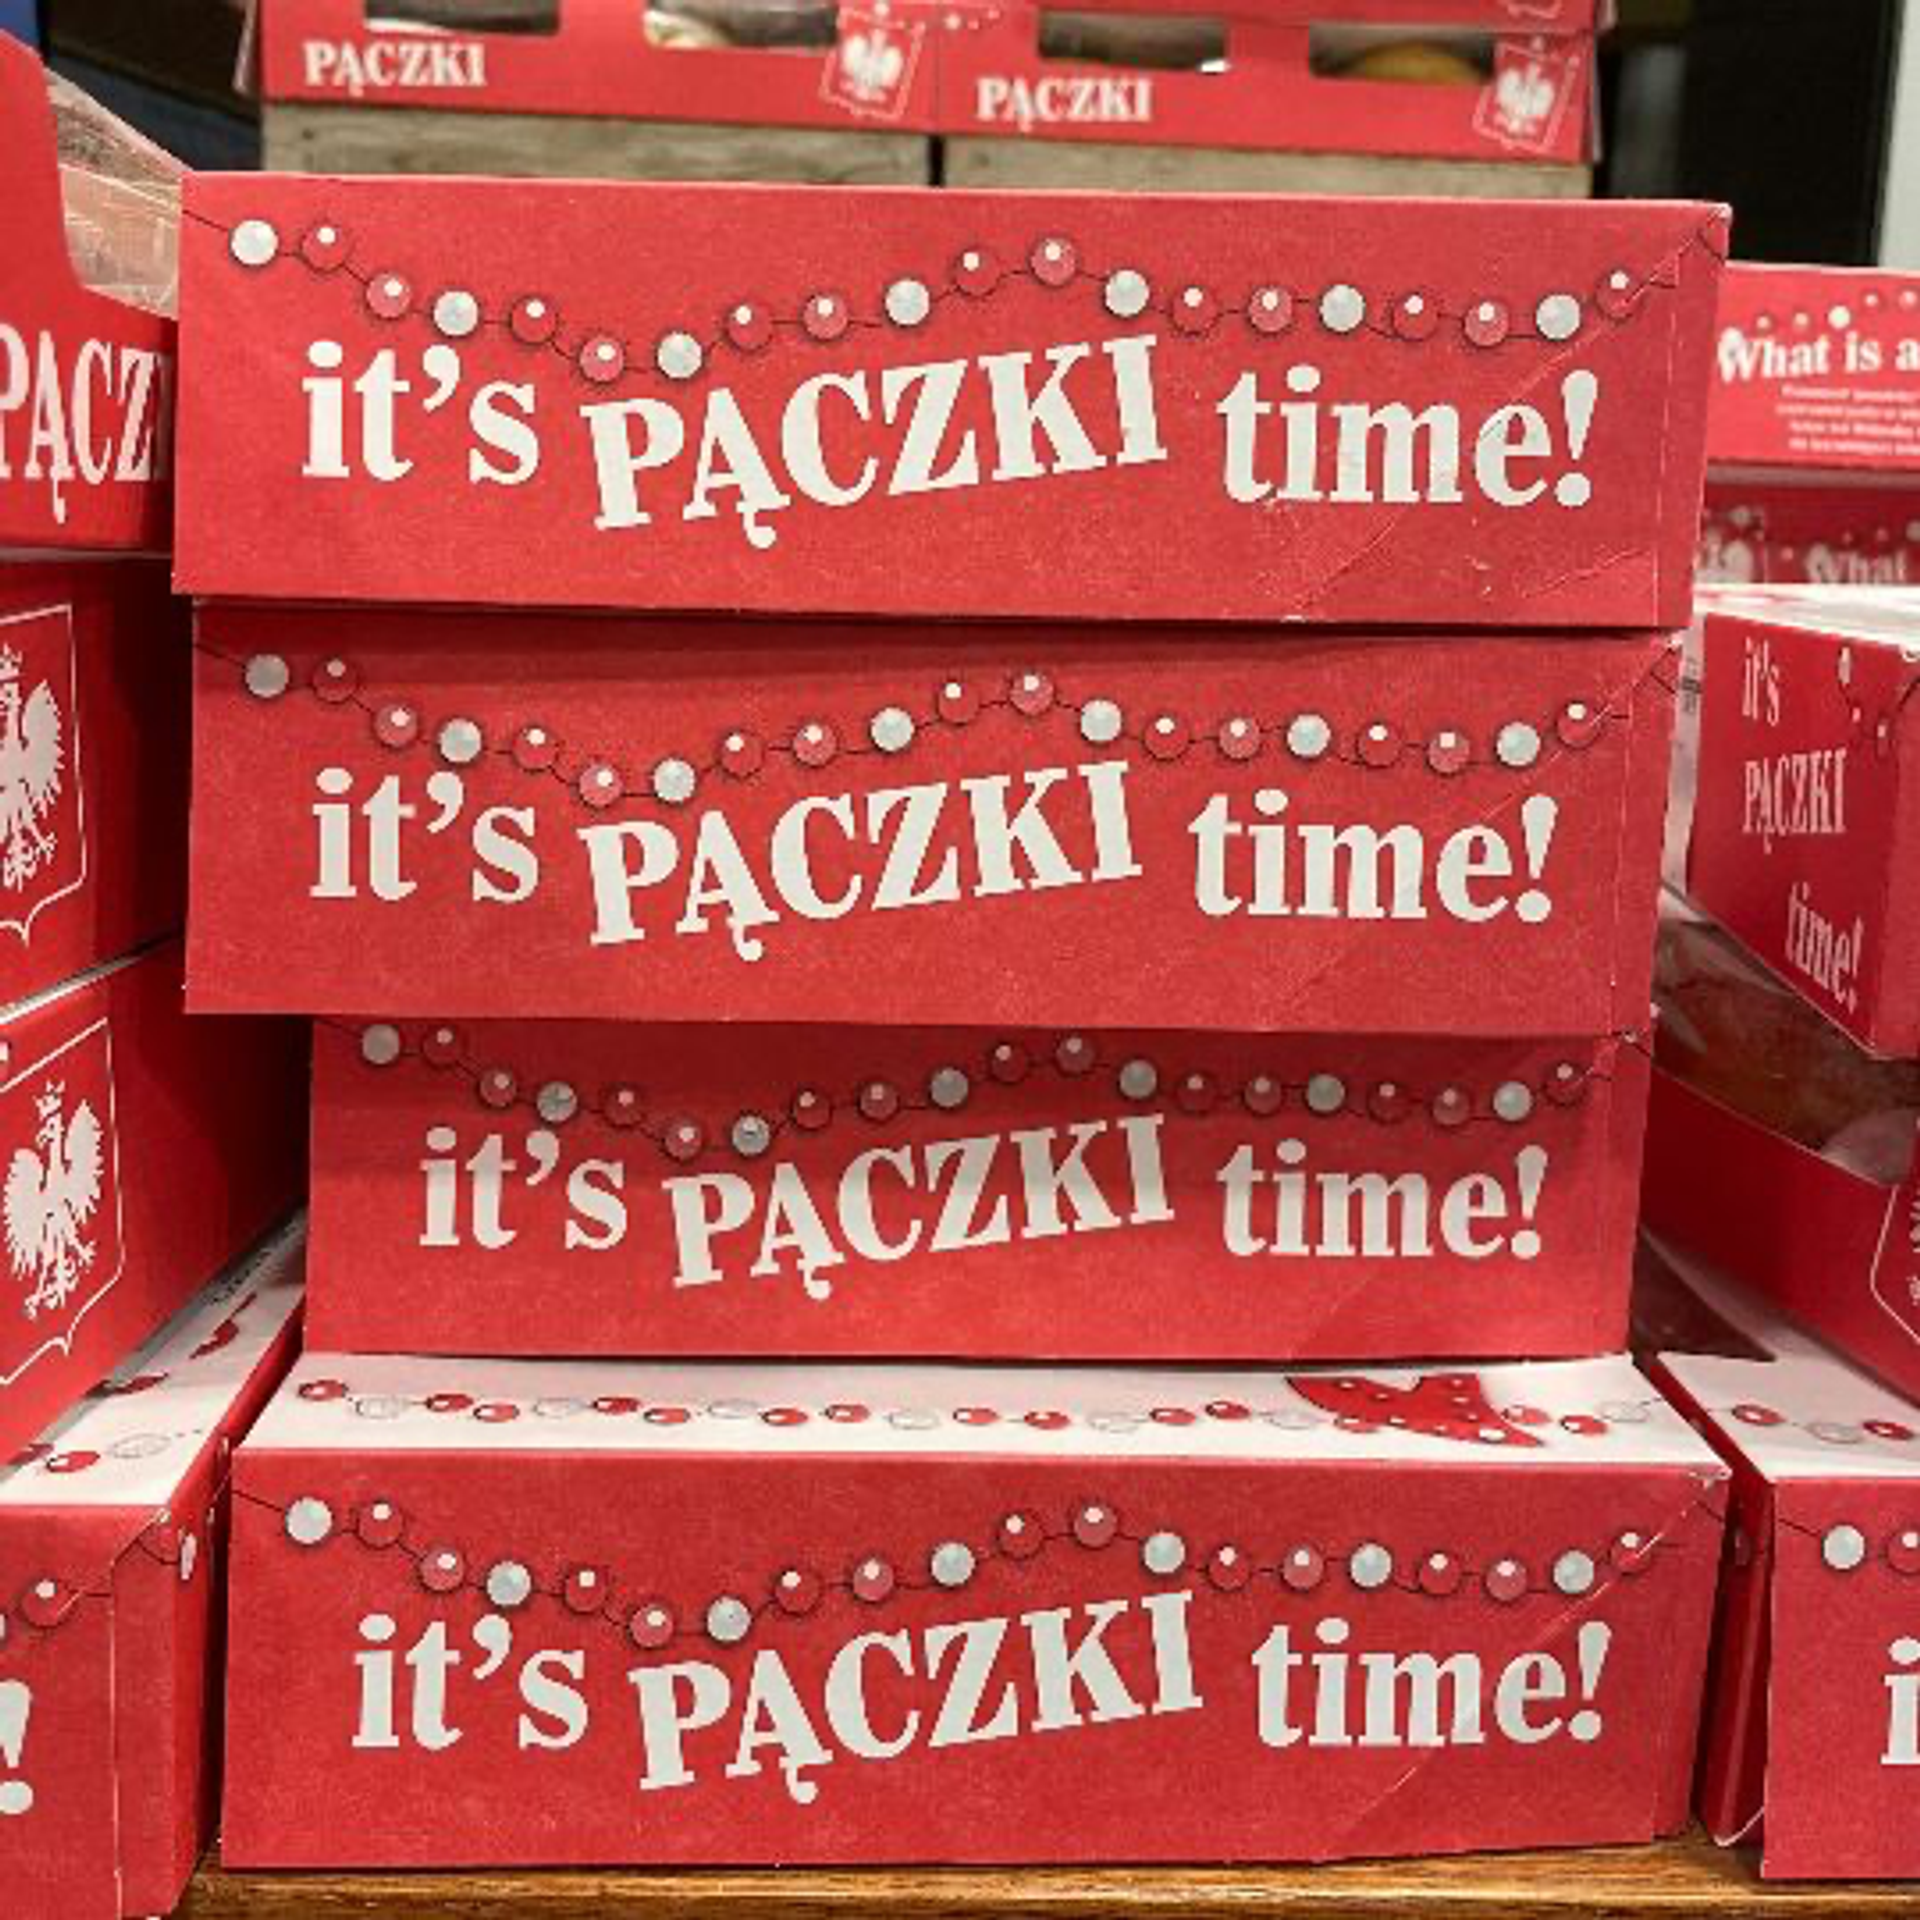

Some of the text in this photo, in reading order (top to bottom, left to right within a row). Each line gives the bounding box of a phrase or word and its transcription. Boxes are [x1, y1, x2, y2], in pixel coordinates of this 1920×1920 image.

[303, 41, 488, 96] PĄCZKI
[975, 77, 1152, 133] PĄCZKI
[0, 322, 172, 524] PĄCZ
[1717, 331, 1920, 384] What is a
[302, 334, 1599, 549] it’s PĄCZKI time!
[310, 760, 1559, 963] it’s PĄCZKI time!
[1742, 748, 1848, 855] PĄCZKI
[1785, 881, 1865, 1014] time!
[419, 1116, 1547, 1300] it’s PĄCZKI time!
[351, 1590, 1612, 1805] it’s PĄCZKI time!
